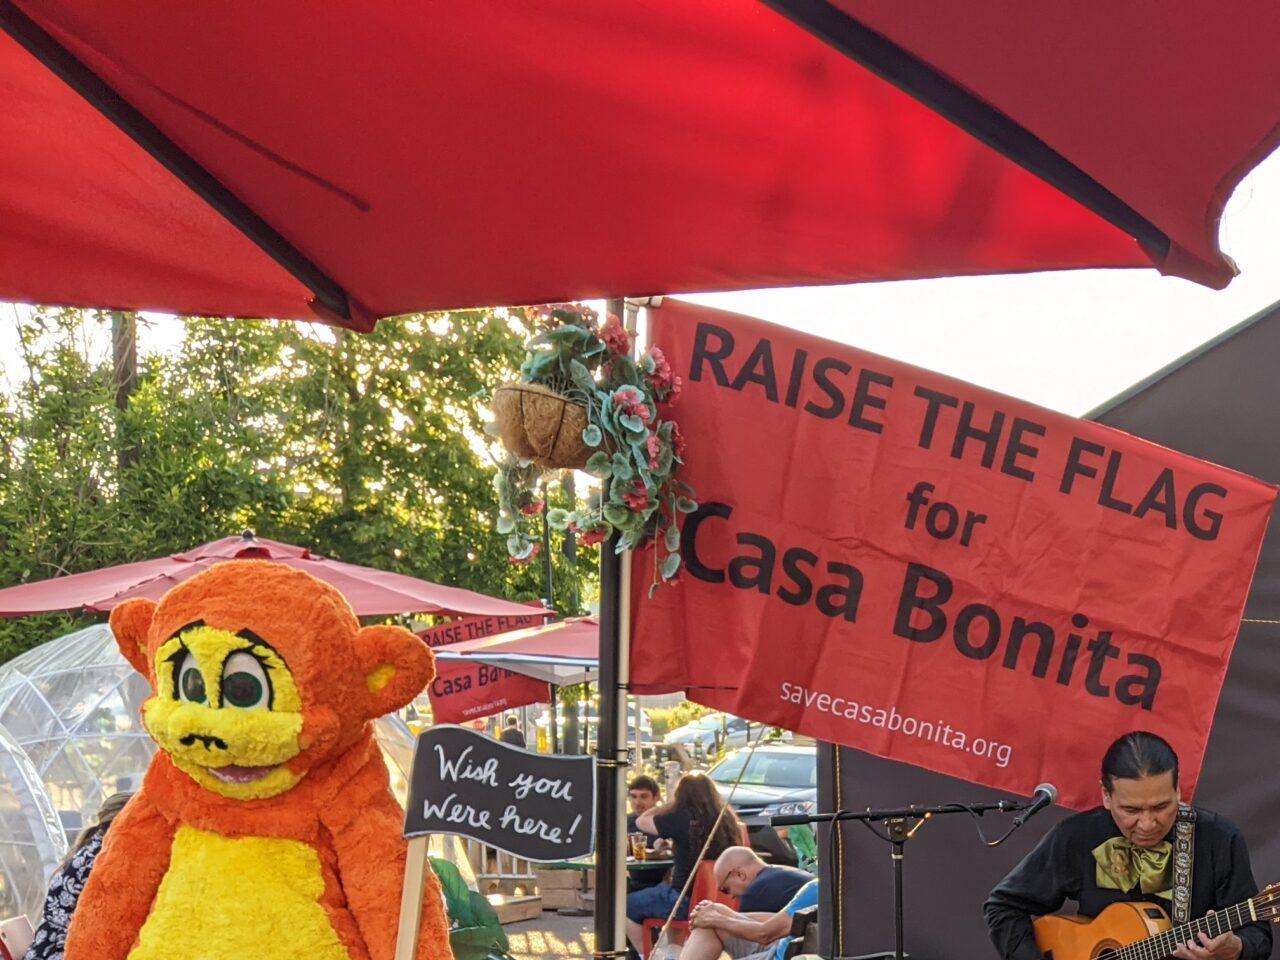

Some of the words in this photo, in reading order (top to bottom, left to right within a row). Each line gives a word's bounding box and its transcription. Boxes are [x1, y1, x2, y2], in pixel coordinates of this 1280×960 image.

[688, 322, 894, 434] RAISE
[910, 385, 1046, 482] THE
[1059, 436, 1228, 541] FLAG
[904, 481, 987, 548] for
[422, 627, 461, 647] RAISE
[465, 620, 493, 640] THE
[681, 501, 865, 624] Casa
[892, 563, 1163, 711] Bonita
[432, 675, 472, 698] Casa
[779, 679, 1012, 767] savecasabonita.org
[434, 744, 499, 787] Wish
[508, 771, 573, 800] you
[499, 805, 583, 845] here!
